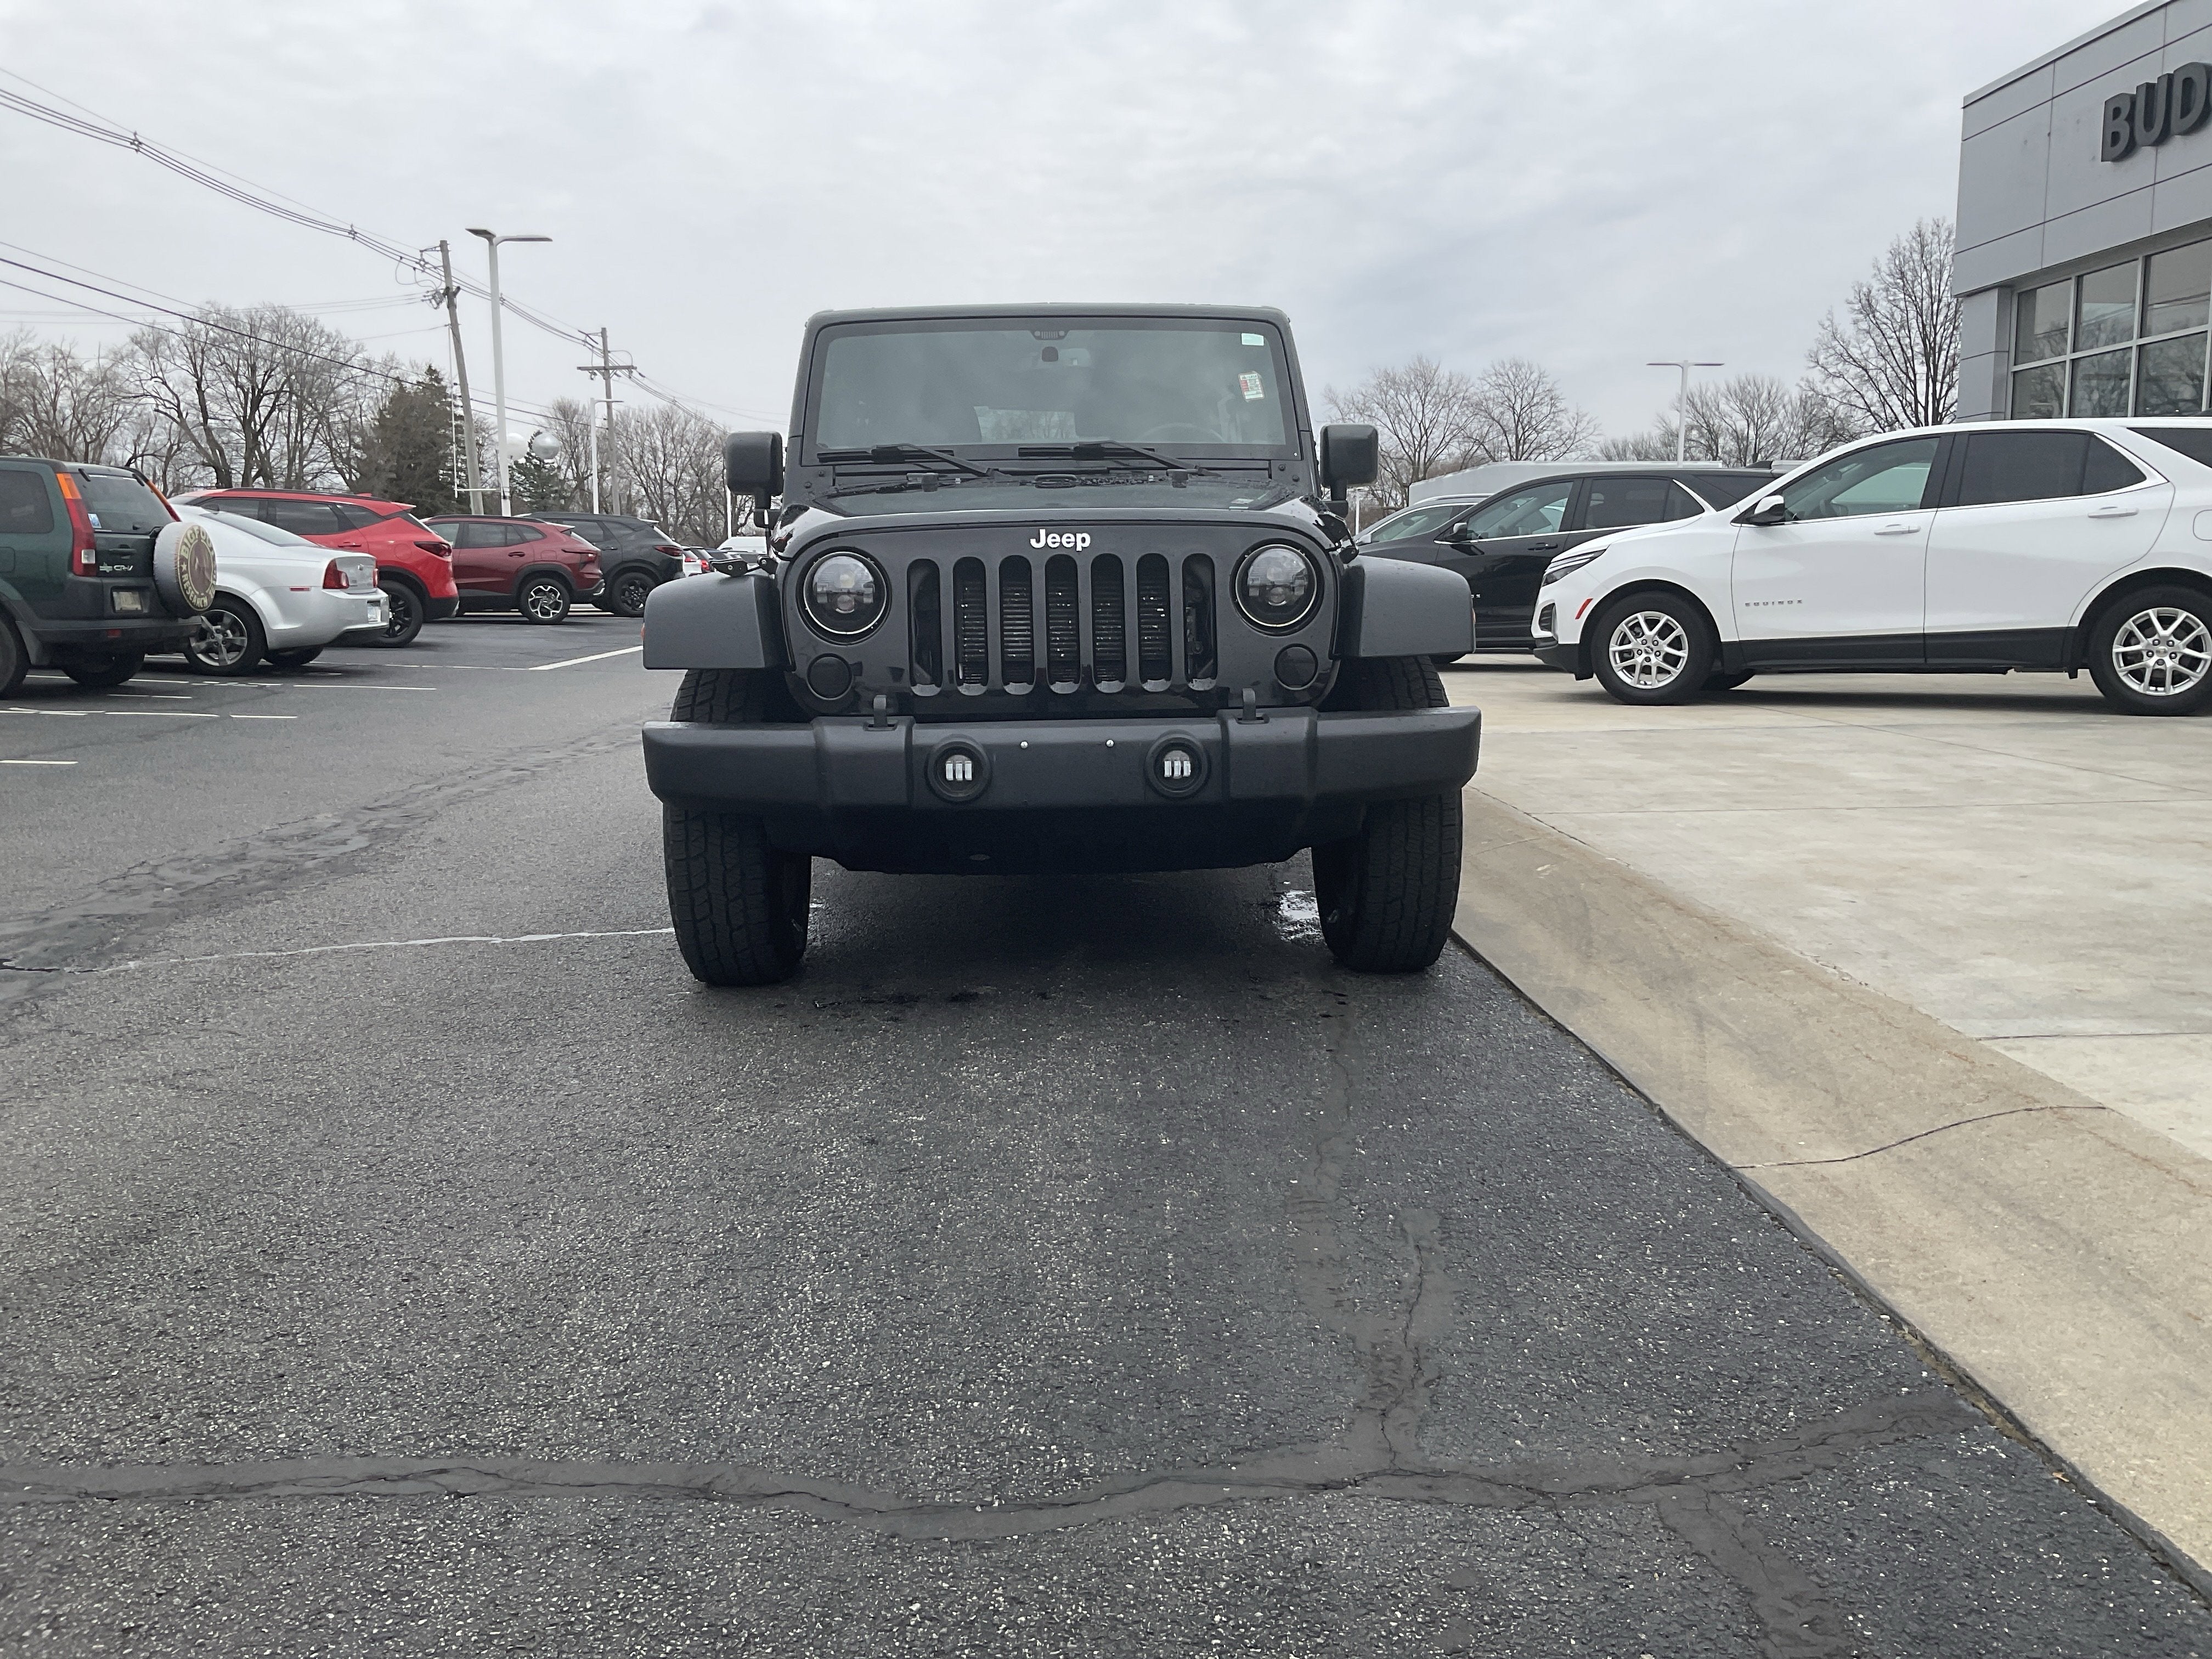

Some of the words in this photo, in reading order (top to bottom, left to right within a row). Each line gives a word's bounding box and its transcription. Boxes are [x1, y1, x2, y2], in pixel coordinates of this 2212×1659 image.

[2101, 61, 2212, 162] BUD
[1030, 528, 1091, 551] Jeep
[182, 573, 208, 607] RESEARCH
